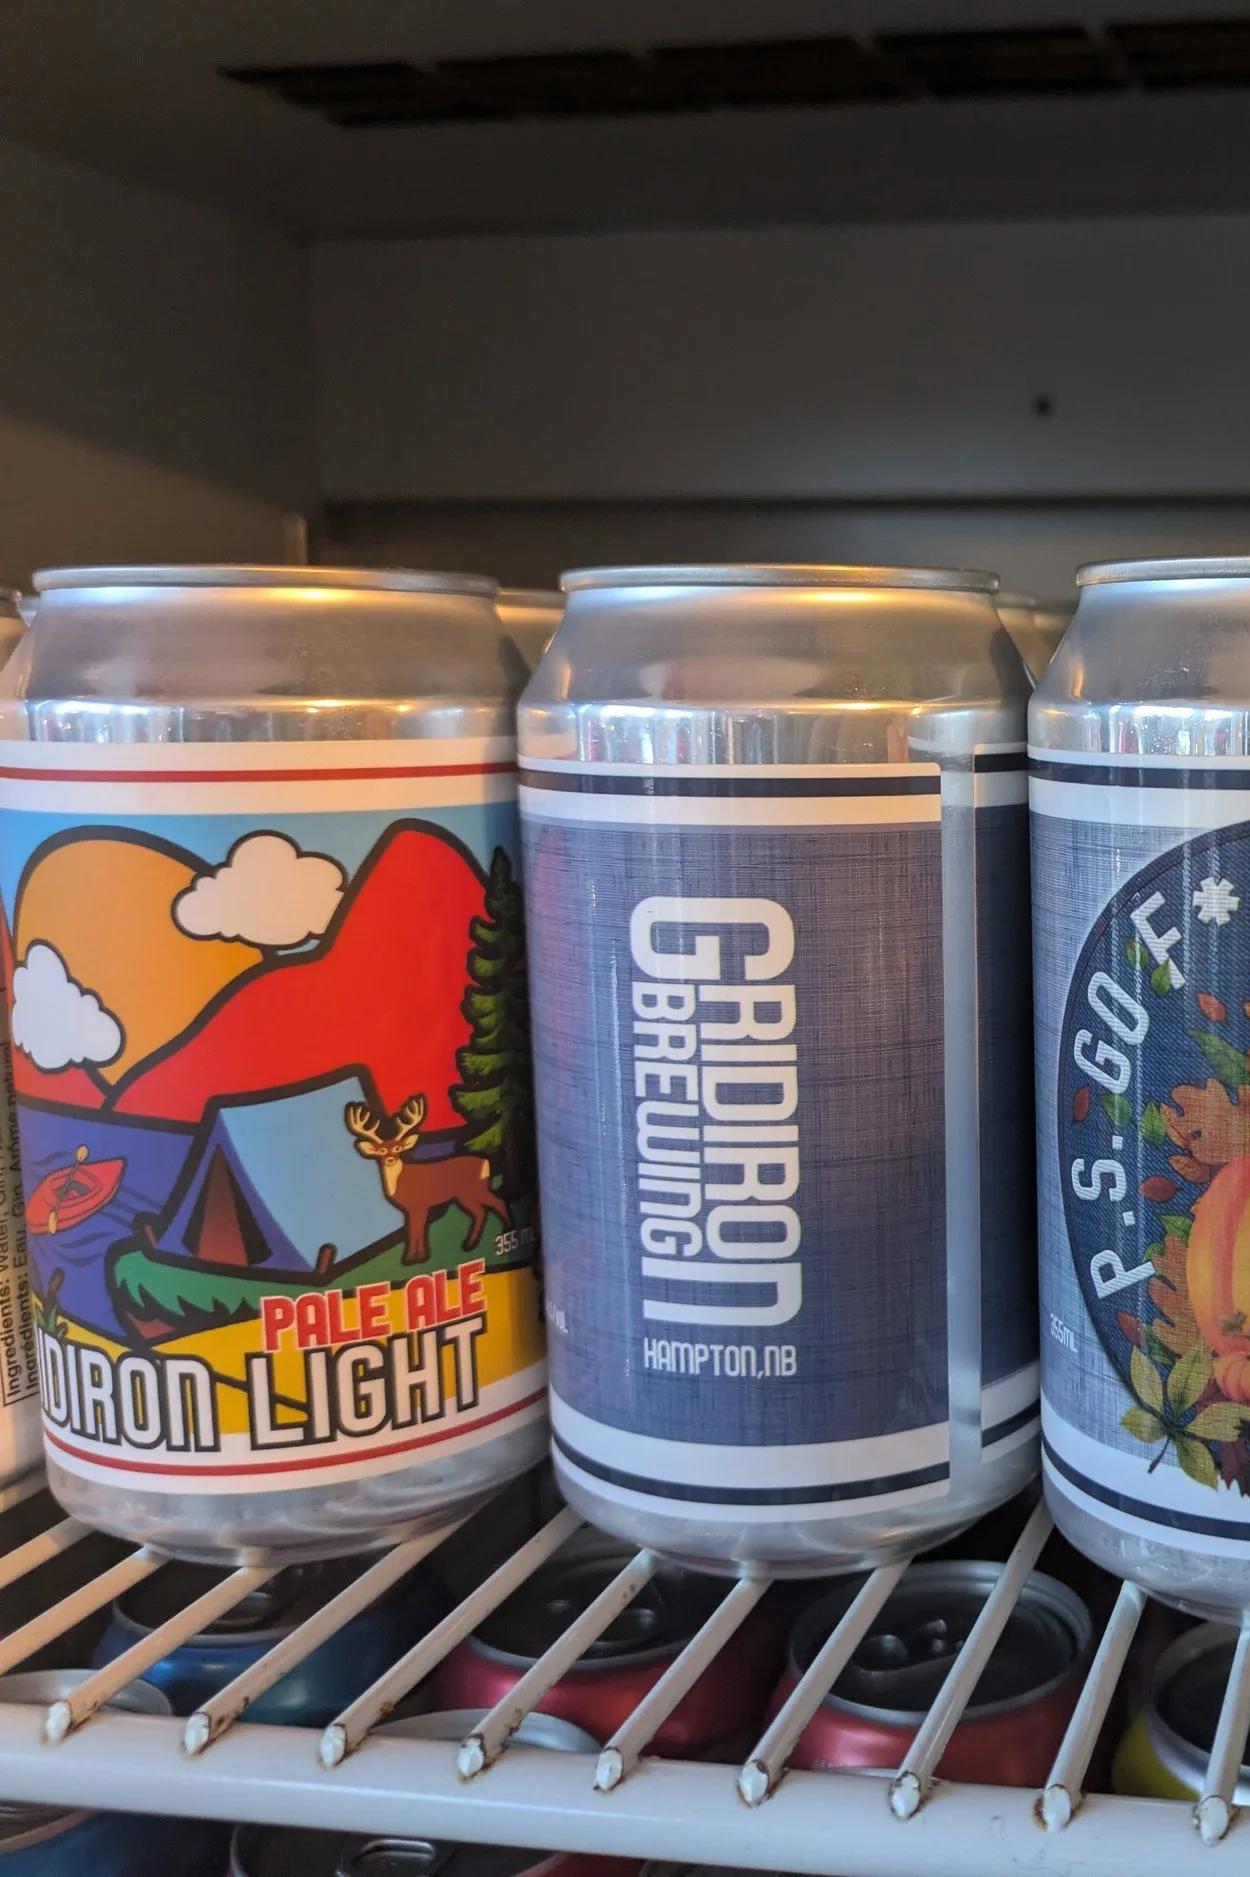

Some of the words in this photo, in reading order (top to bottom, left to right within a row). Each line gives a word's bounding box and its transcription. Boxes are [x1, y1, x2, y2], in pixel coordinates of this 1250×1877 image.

[1073, 970, 1151, 1096] GO
[629, 896, 803, 1327] GRIDIRON
[631, 981, 703, 1258] BREWING
[260, 1281, 392, 1353] PALE
[404, 1257, 488, 1330] ALE
[245, 1312, 487, 1451] LIGHT
